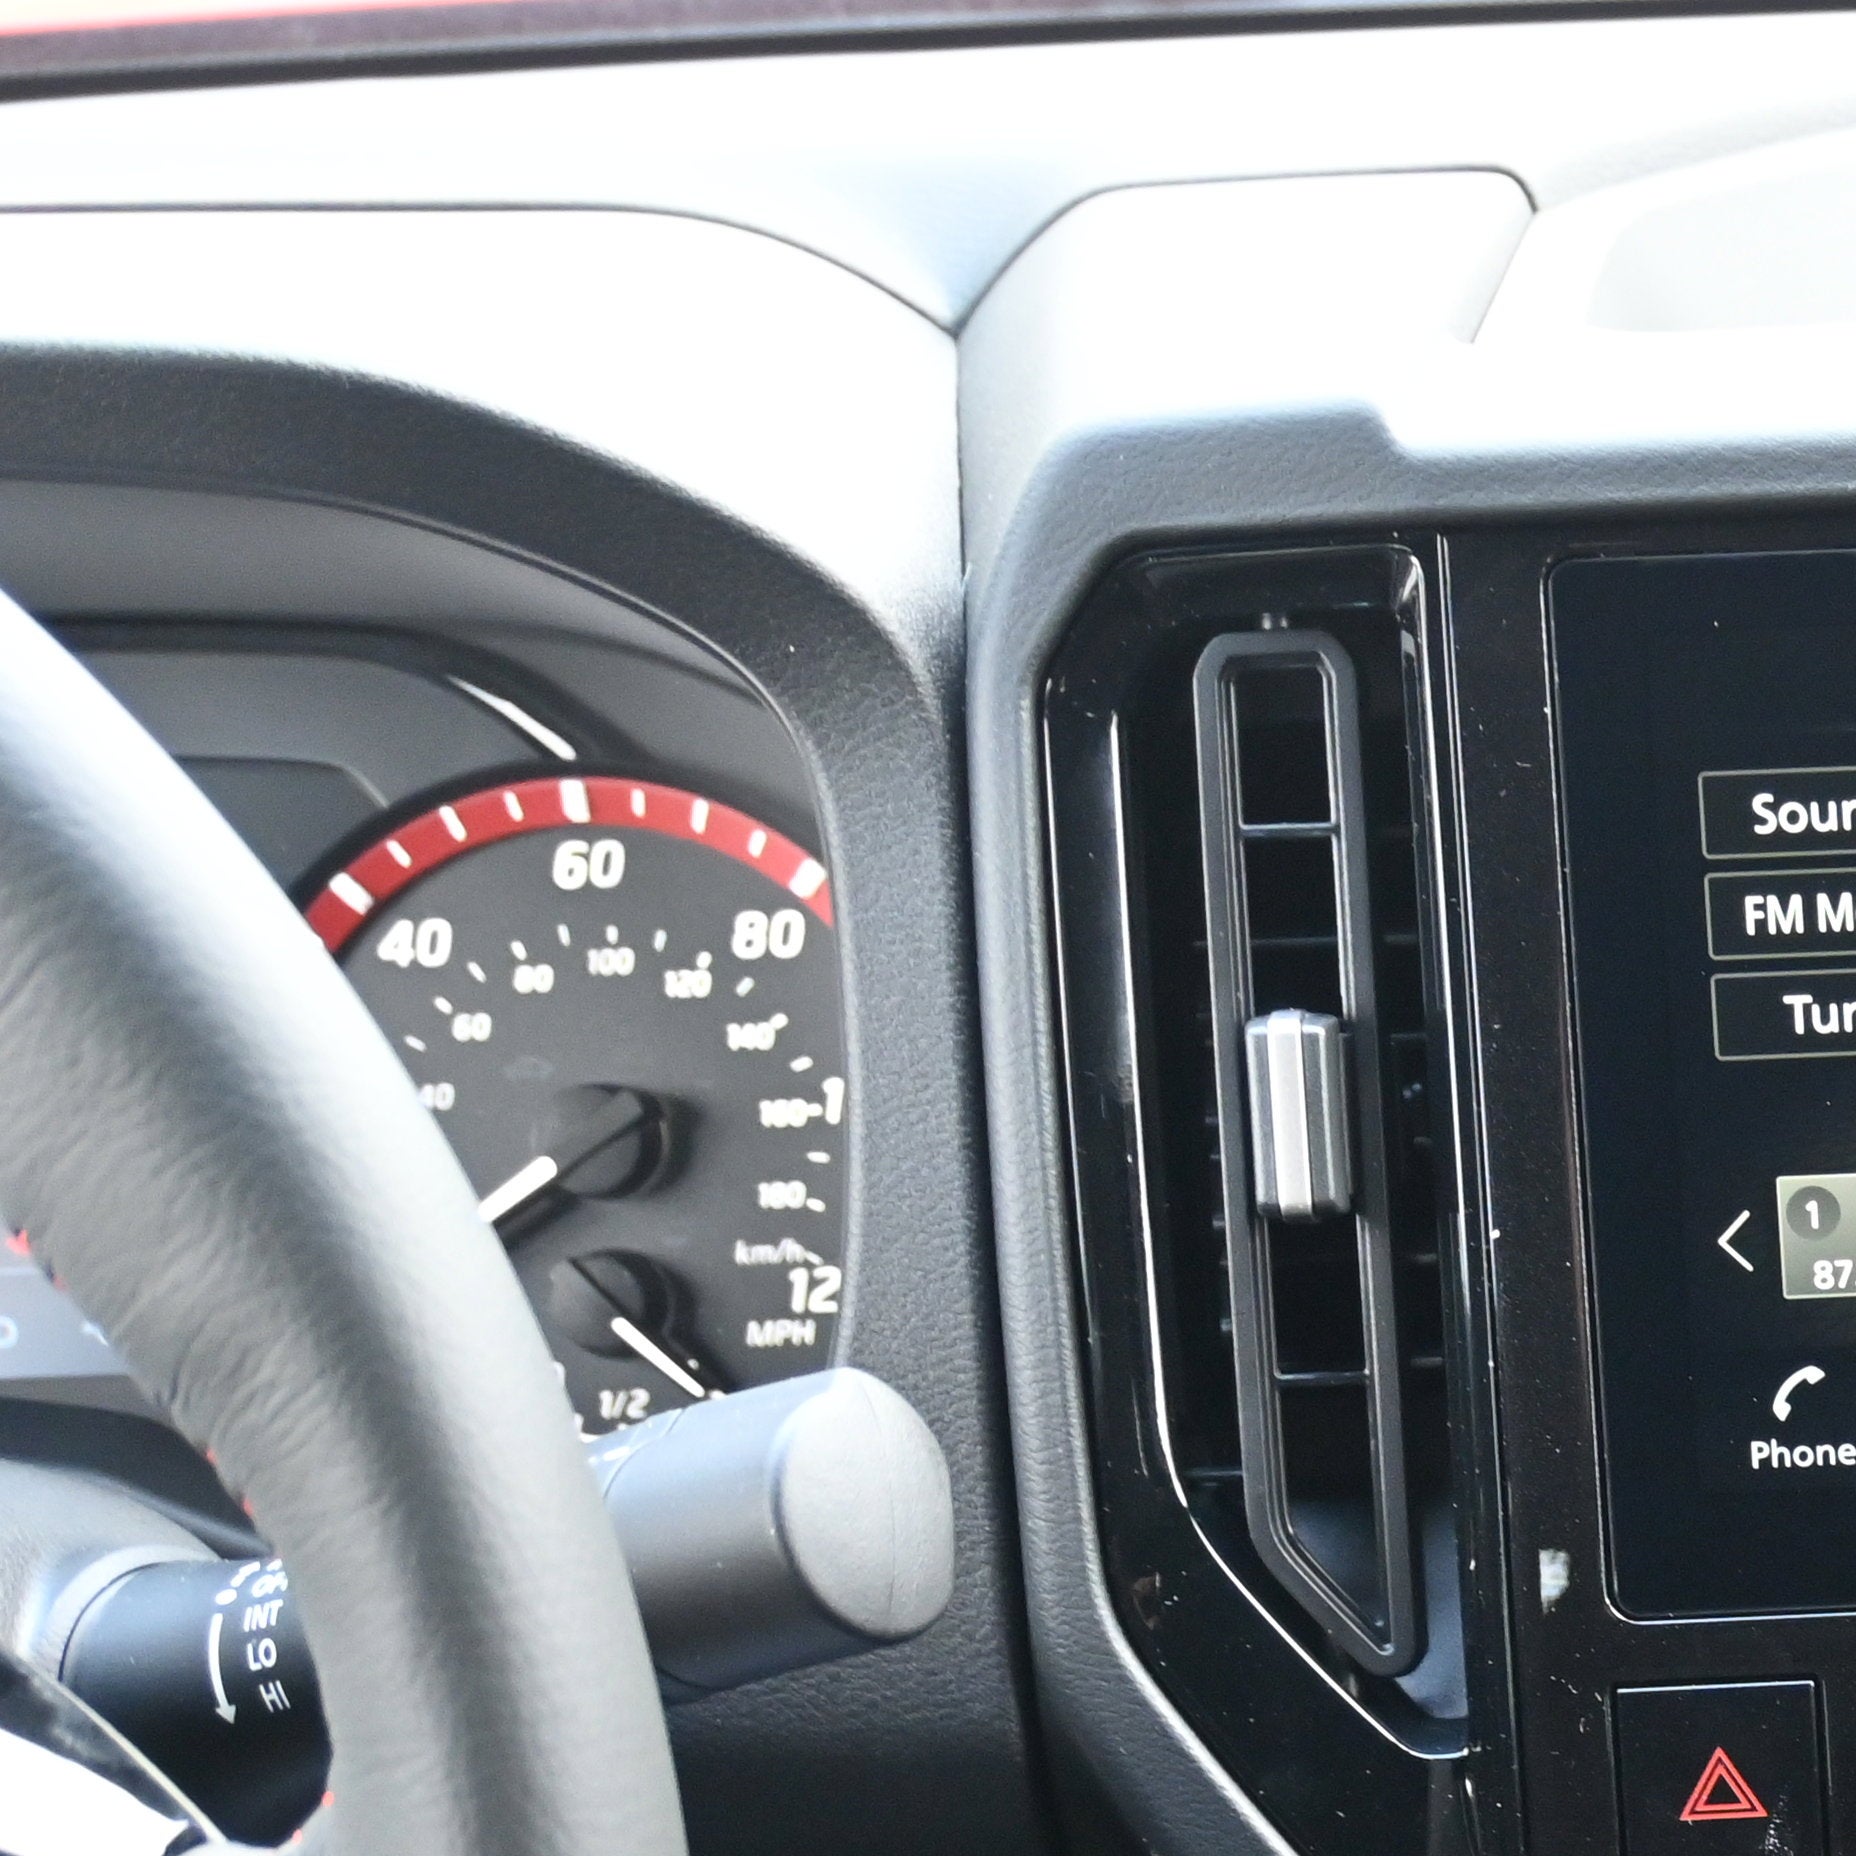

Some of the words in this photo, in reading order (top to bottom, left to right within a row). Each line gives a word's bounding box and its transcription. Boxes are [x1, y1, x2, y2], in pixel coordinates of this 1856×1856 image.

[551, 839, 626, 891] 60
[1744, 893, 1805, 936] FM
[376, 917, 453, 968] 40
[730, 908, 806, 960] 80
[587, 946, 636, 976] 100
[664, 967, 713, 999] 120
[451, 1012, 492, 1042] 60
[1804, 1199, 1820, 1230] 1
[788, 1265, 842, 1314] 12
[745, 1319, 816, 1347] MPH
[242, 1598, 285, 1633] INT
[246, 1637, 278, 1672] LO
[258, 1679, 291, 1712] HI
